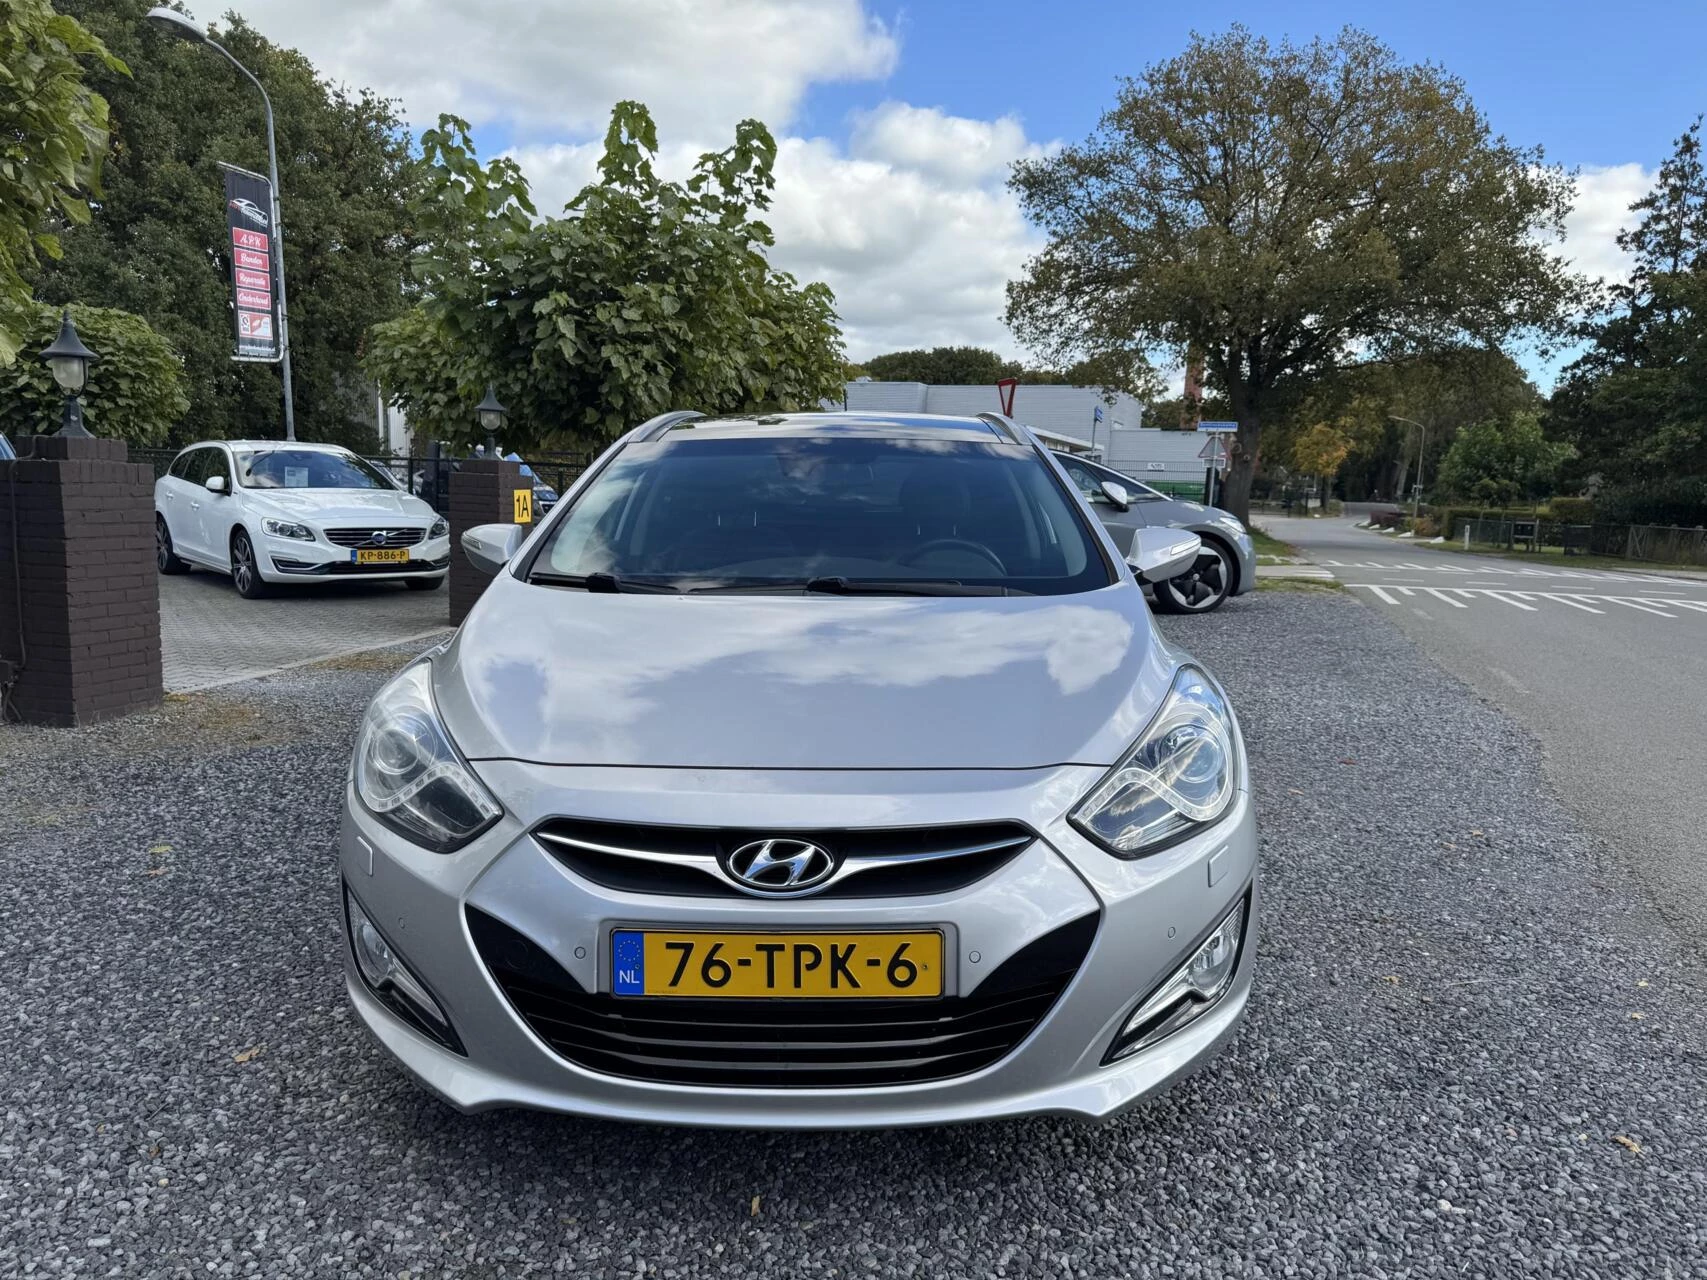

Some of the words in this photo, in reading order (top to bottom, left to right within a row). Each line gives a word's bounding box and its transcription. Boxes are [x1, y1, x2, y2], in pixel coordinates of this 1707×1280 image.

[240, 253, 263, 265] Banden
[238, 292, 269, 305] Onderhoud
[516, 495, 530, 518] 1A
[360, 551, 406, 560] KP-886-P
[665, 941, 918, 989] 76-TPK-6
[619, 969, 639, 983] NL
